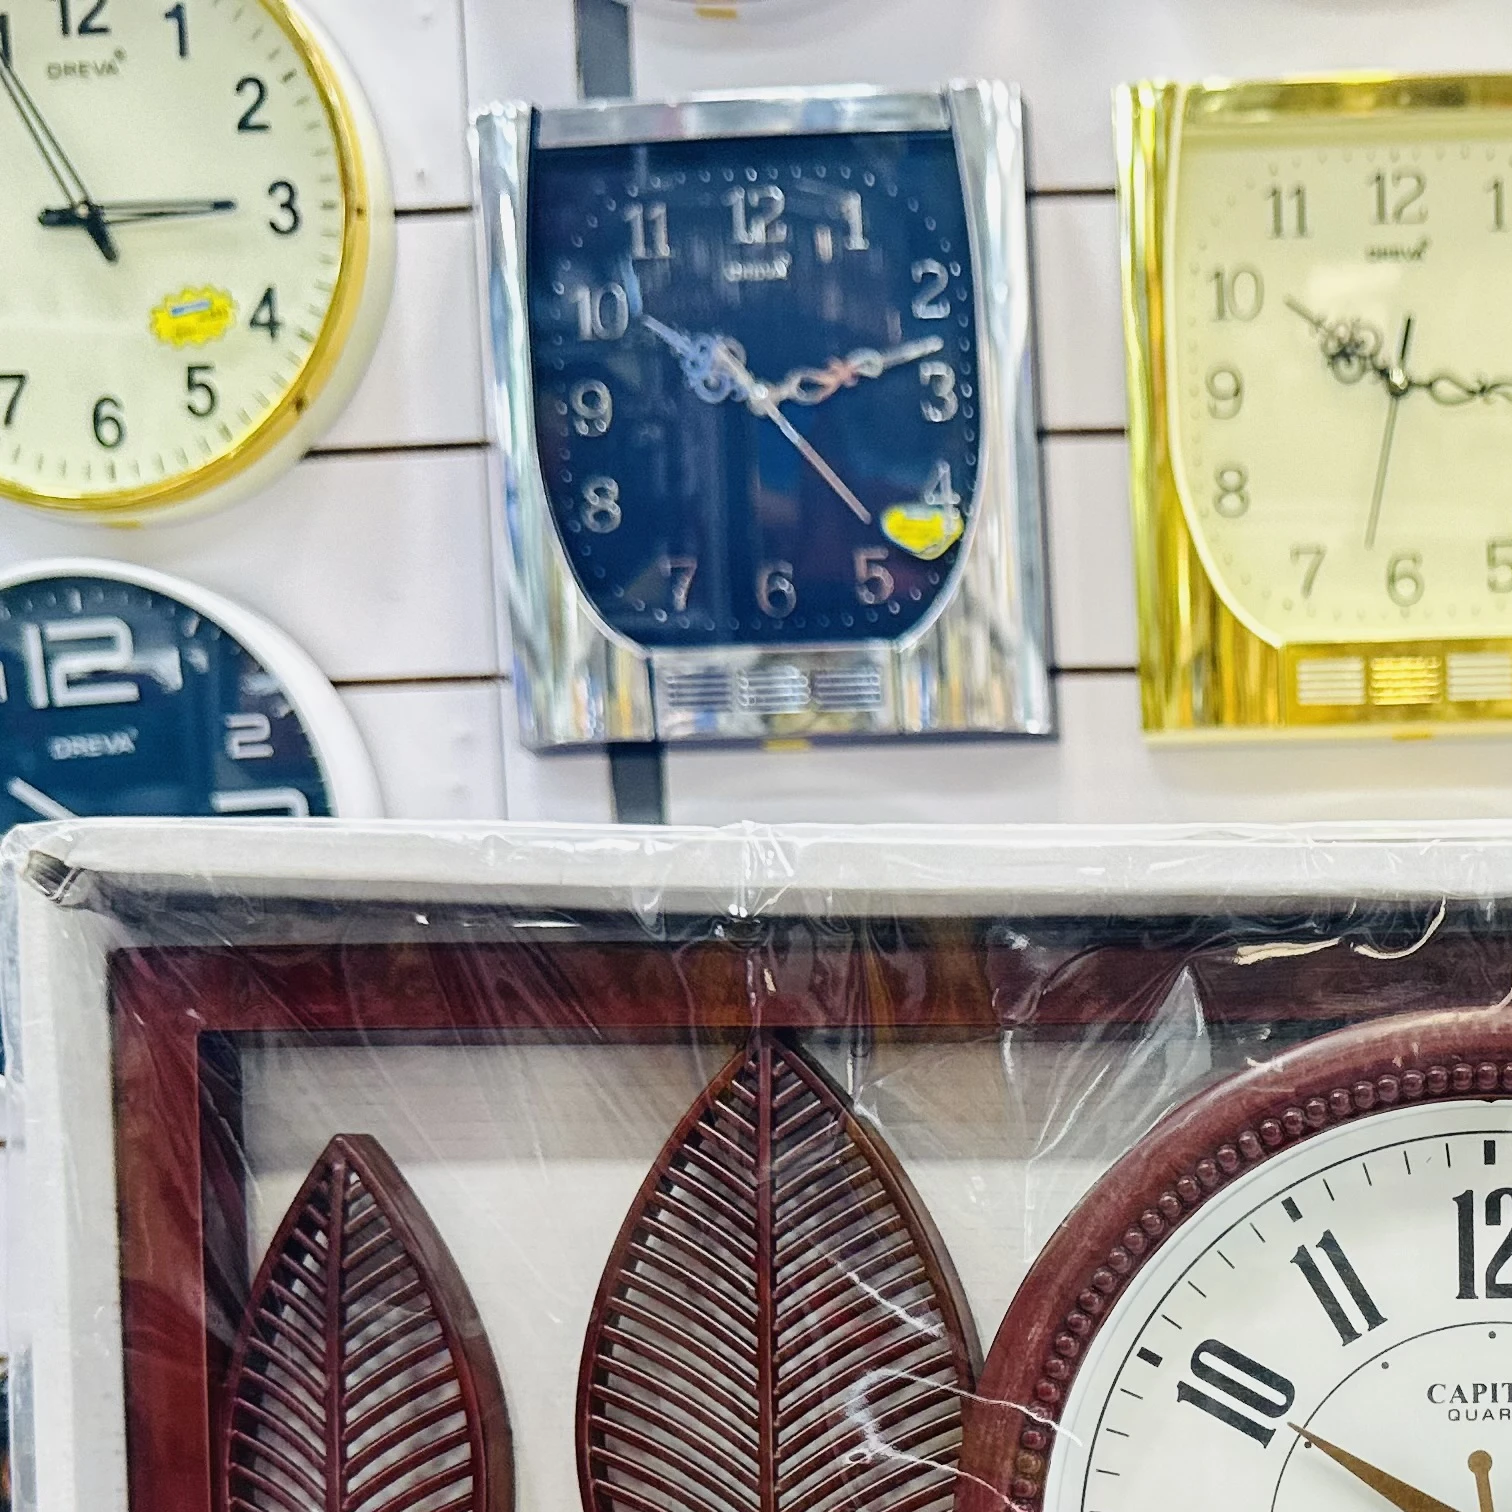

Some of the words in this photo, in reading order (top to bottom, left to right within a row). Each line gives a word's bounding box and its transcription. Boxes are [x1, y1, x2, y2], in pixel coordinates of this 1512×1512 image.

[164, 3, 189, 58] 1
[235, 76, 270, 132] 2
[267, 180, 299, 235] 3
[722, 185, 788, 245] 12
[842, 190, 870, 251] 1
[1266, 183, 1310, 239] 11
[1366, 165, 1429, 225] 12
[1484, 174, 1509, 233] 1
[624, 203, 671, 259] 11
[250, 286, 282, 340] 4
[574, 282, 629, 342] 10
[910, 258, 950, 319] 2
[1208, 264, 1265, 322] 10
[0, 374, 28, 427] 7
[186, 365, 219, 418] 5
[571, 380, 613, 437] 9
[920, 360, 958, 422] 3
[1205, 369, 1243, 421] 9
[92, 397, 126, 449] 6
[582, 475, 622, 533] 8
[924, 461, 961, 537] 4
[1214, 463, 1250, 519] 8
[662, 556, 698, 612] 7
[757, 560, 798, 619] 6
[854, 547, 895, 605] 5
[1290, 545, 1327, 599] 7
[1386, 551, 1425, 607] 6
[23, 616, 140, 709] 12
[225, 712, 274, 760] 2
[1290, 1229, 1388, 1347] 11
[1177, 1339, 1296, 1449] 10
